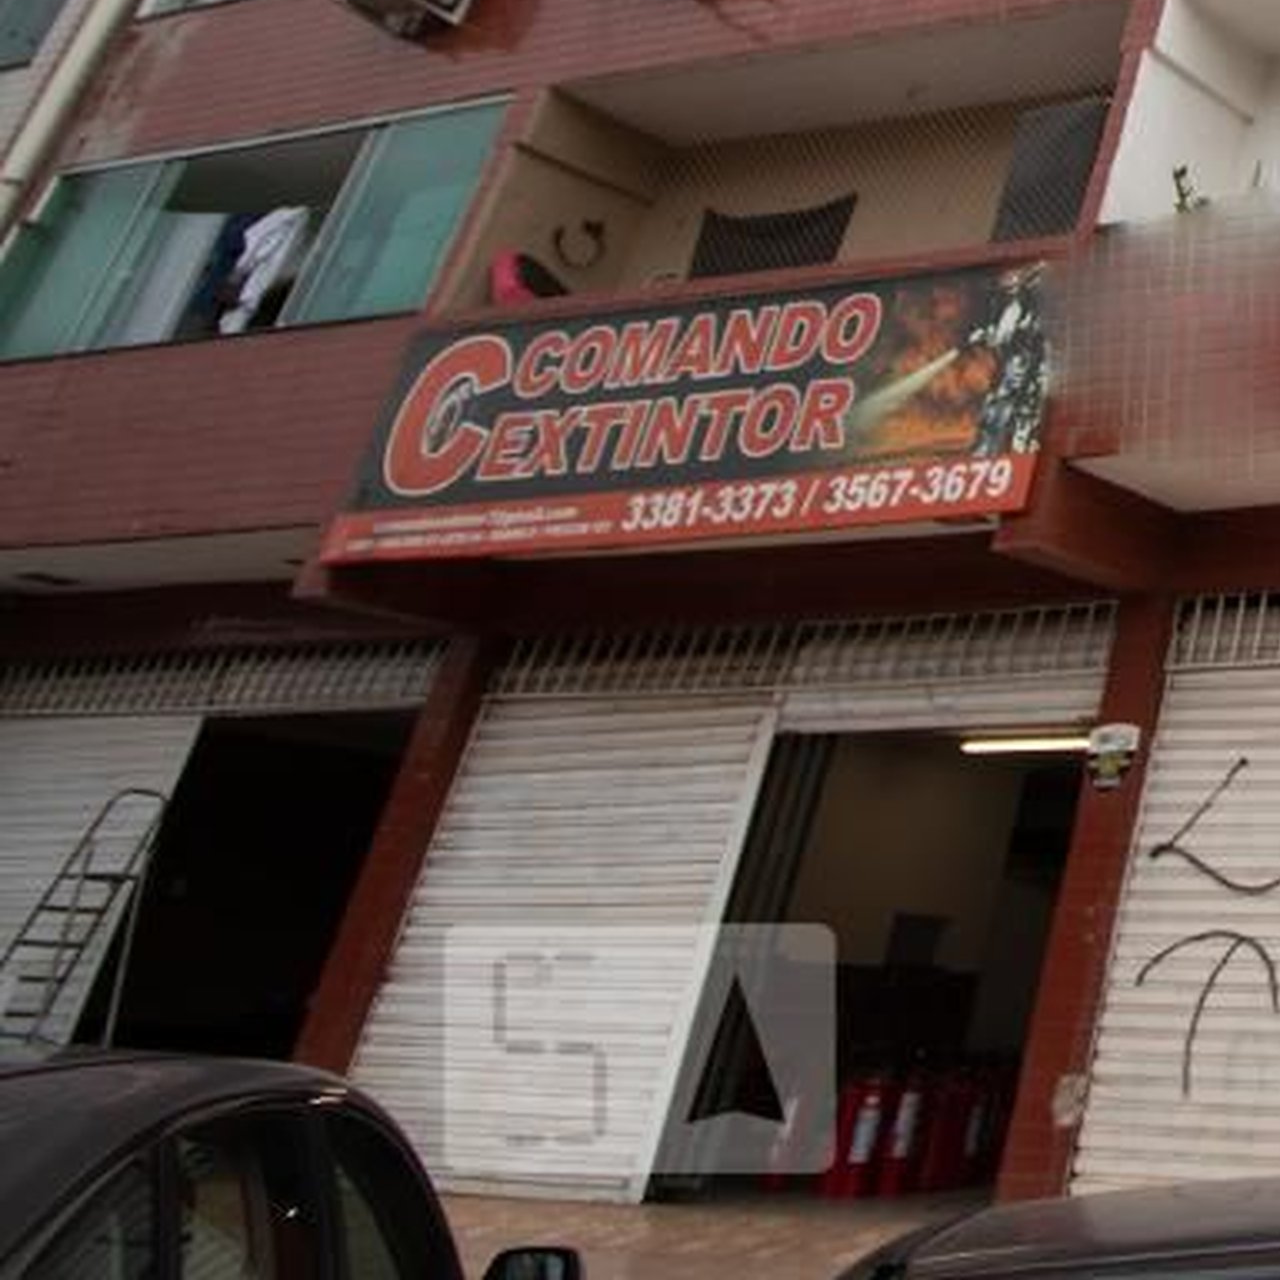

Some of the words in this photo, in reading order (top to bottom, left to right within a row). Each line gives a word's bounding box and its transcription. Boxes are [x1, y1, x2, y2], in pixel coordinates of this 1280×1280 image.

[514, 293, 882, 400] COMANDO
[476, 379, 856, 483] EXTINTOR
[621, 479, 797, 532] 3381-3373
[823, 459, 1012, 514] 3567-3679
